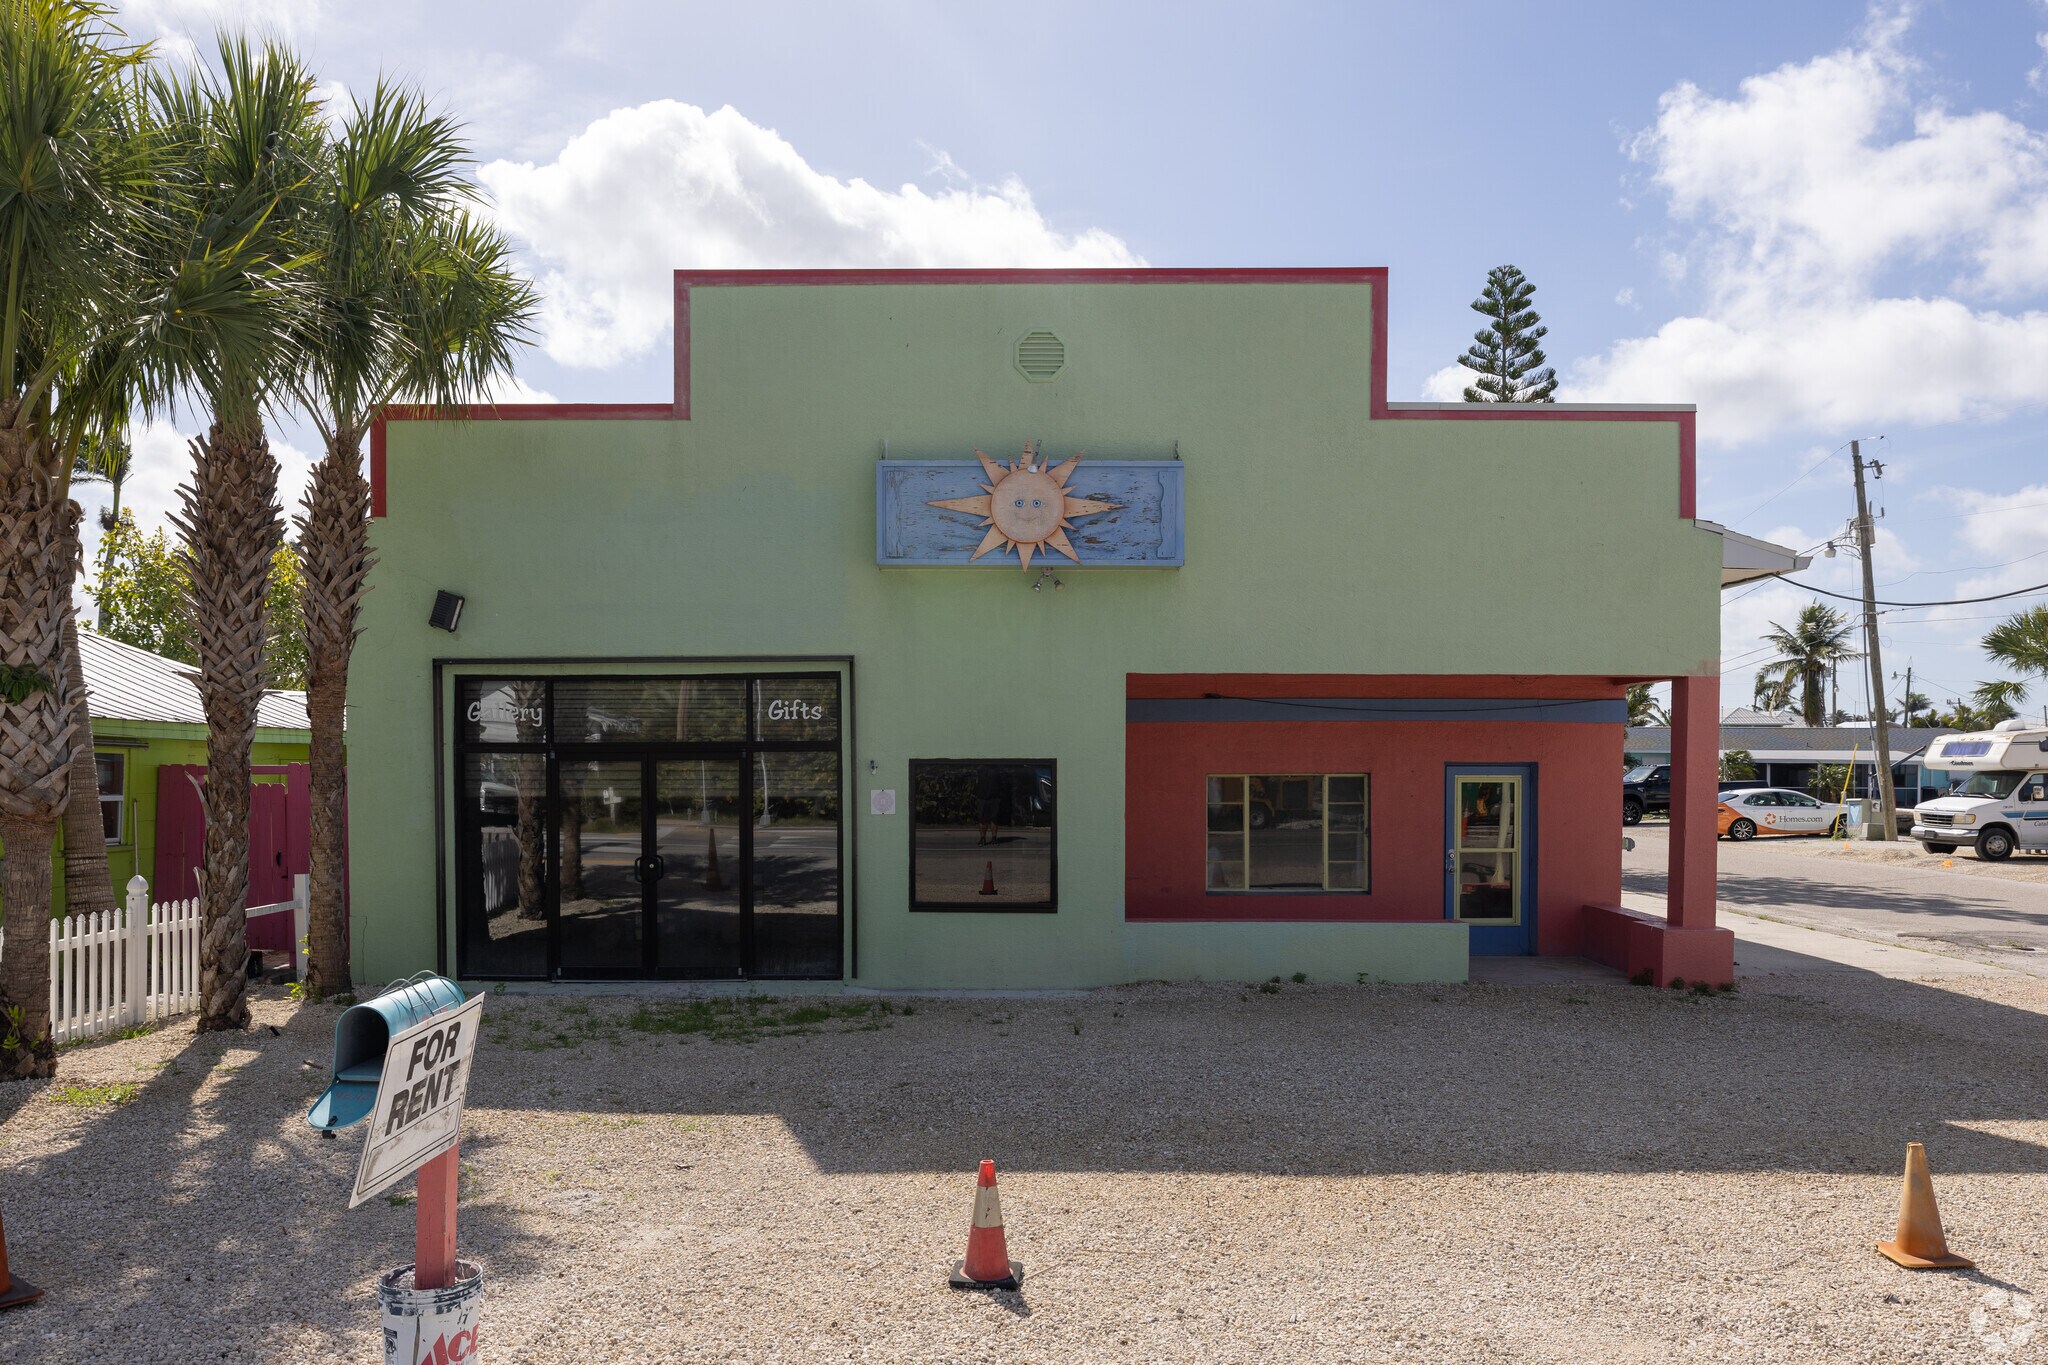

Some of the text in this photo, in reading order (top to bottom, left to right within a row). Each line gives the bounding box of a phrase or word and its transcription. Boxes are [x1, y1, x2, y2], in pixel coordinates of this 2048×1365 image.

[768, 699, 822, 720] Gifts
[1779, 815, 1823, 823] Homes.com
[406, 1021, 461, 1082] FOR
[385, 1059, 461, 1136] RENT
